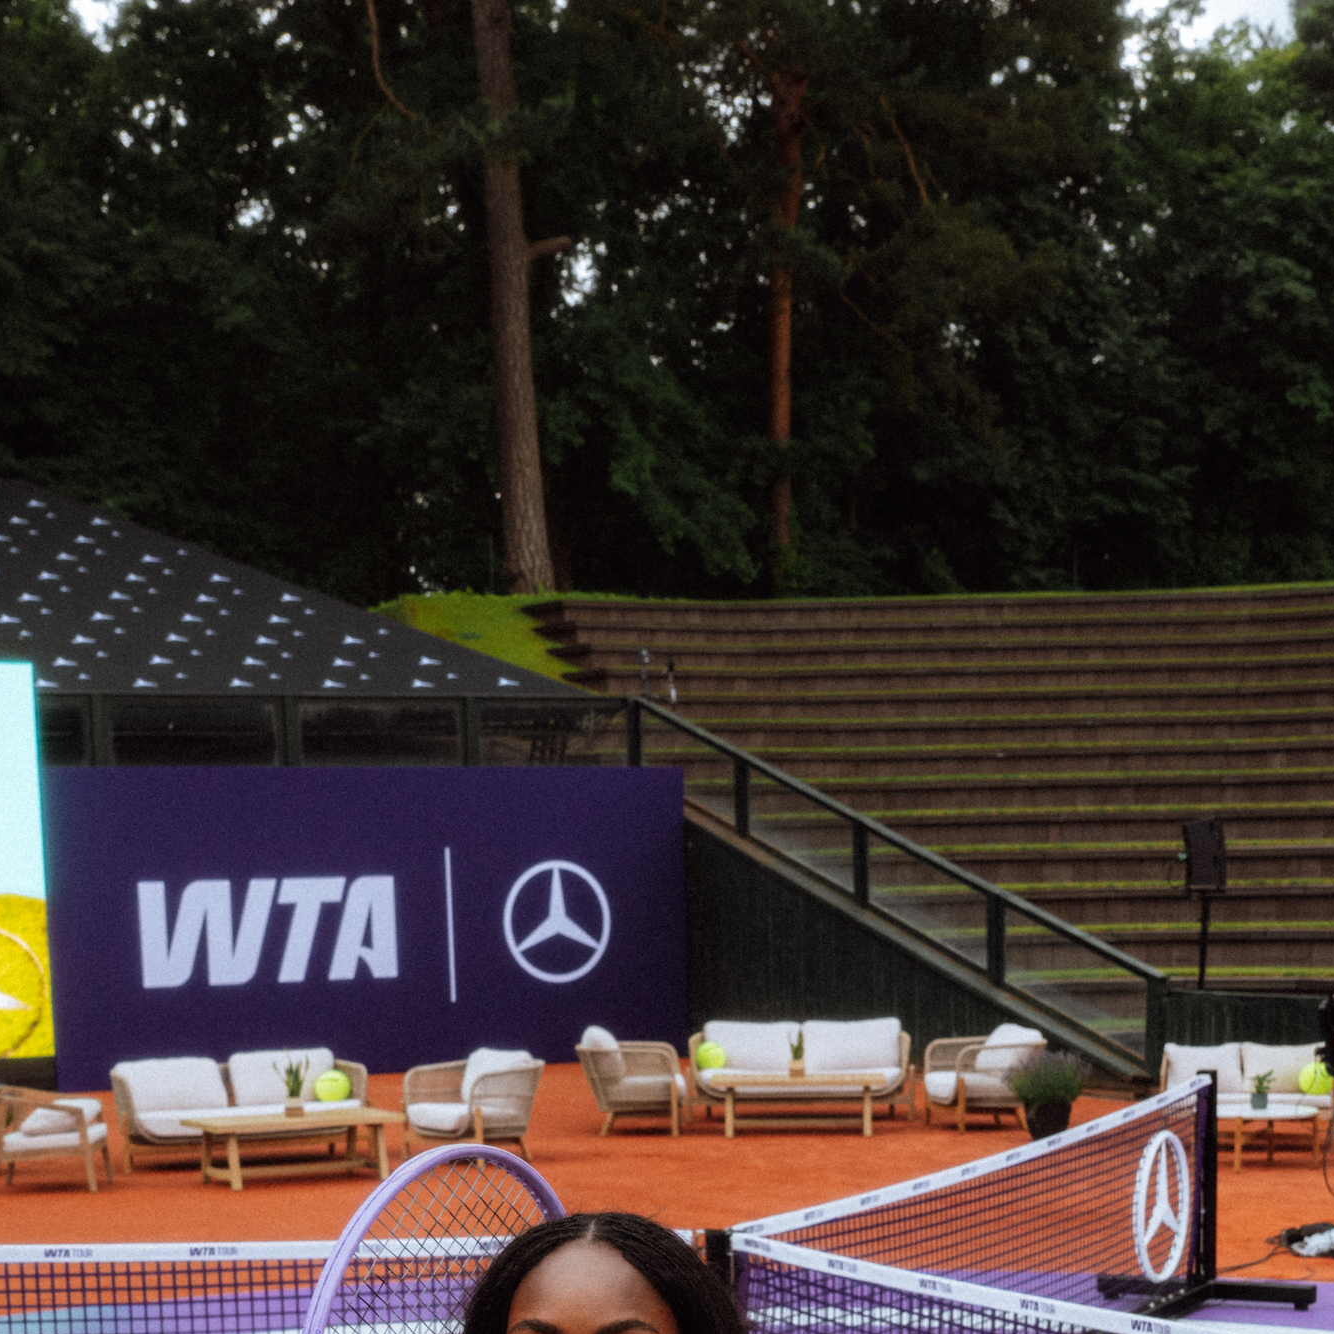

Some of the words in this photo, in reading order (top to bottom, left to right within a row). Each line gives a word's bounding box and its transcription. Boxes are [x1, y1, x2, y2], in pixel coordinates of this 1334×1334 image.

[137, 874, 399, 989] WTA
[1019, 1298, 1039, 1312] WTA
[1131, 1319, 1153, 1333] WTA
